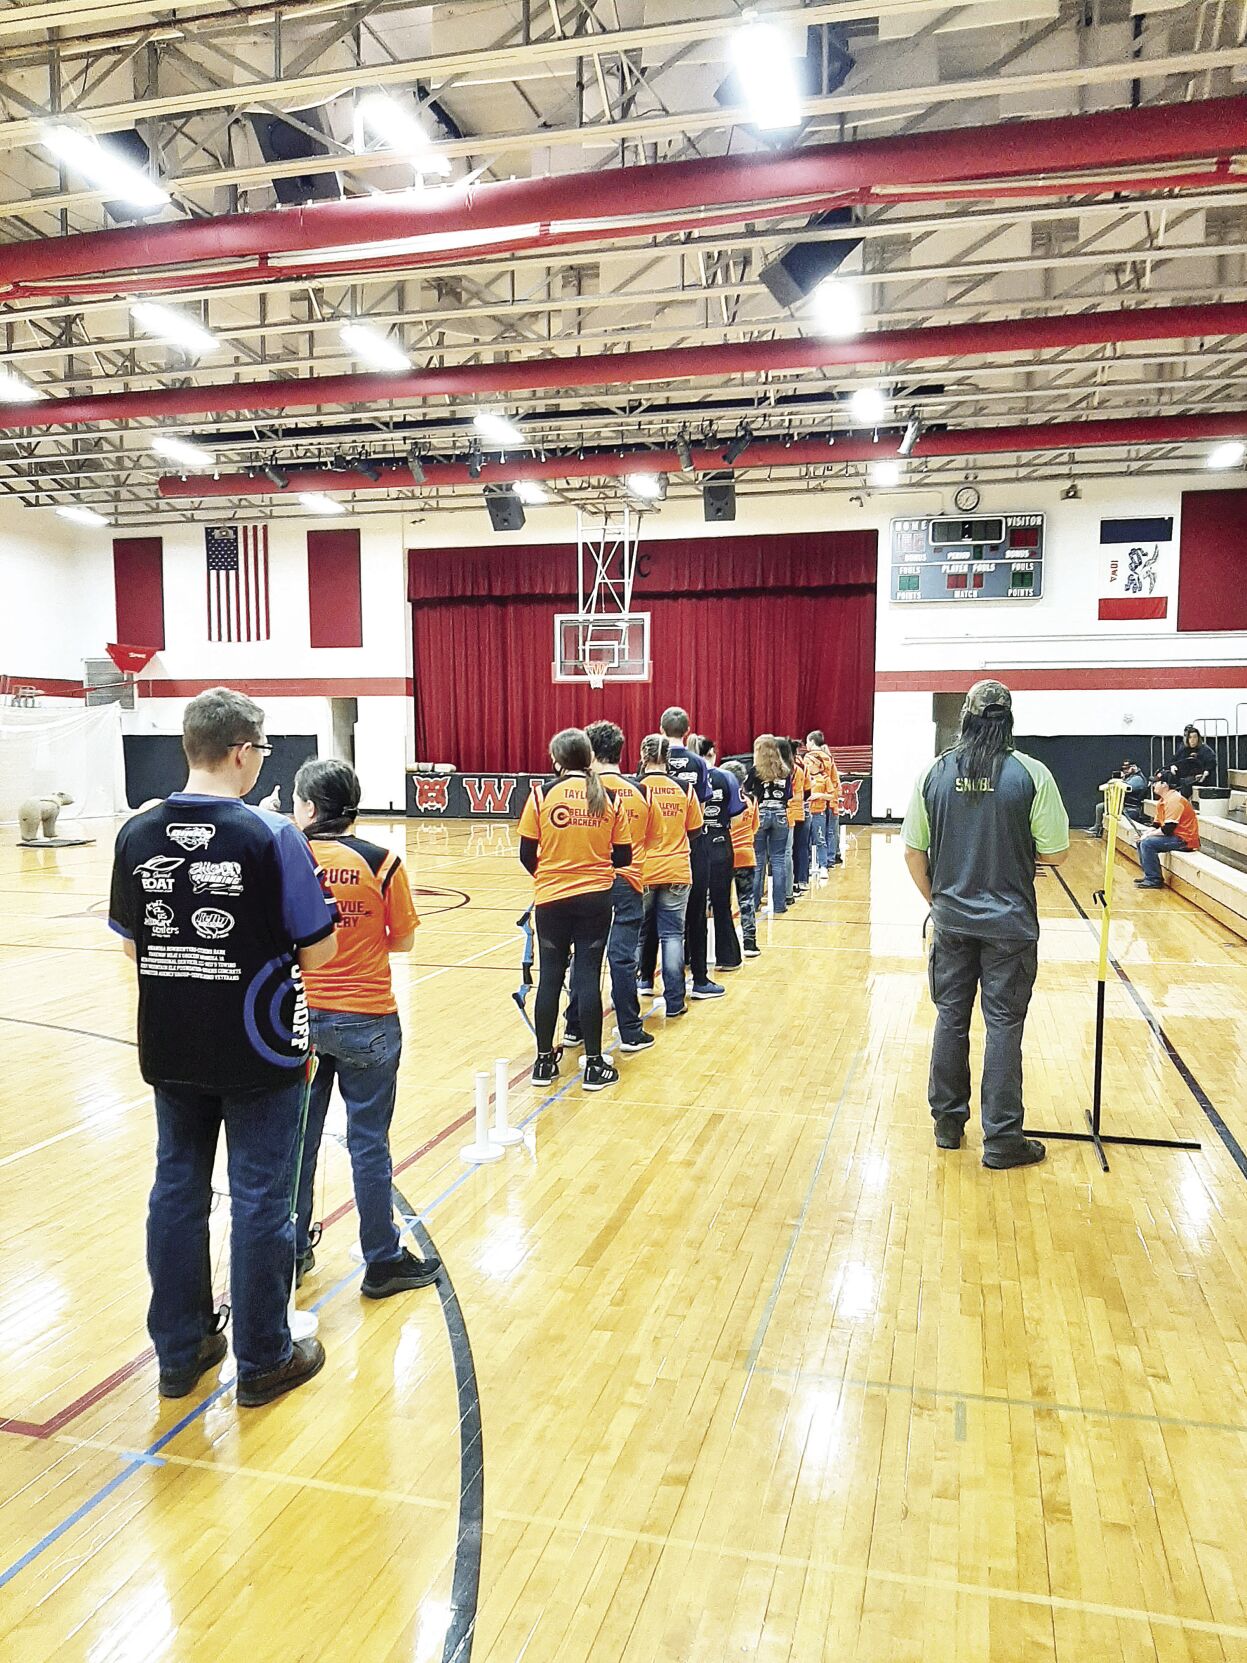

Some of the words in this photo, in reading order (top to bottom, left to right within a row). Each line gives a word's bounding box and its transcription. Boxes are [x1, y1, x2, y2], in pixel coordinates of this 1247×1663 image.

[895, 520, 927, 531] HOME
[1006, 516, 1042, 527] VISITOR
[941, 564, 969, 573] PLAYER
[1011, 562, 1034, 571] FOULS
[1109, 560, 1119, 583] IOWA
[896, 591, 922, 600] POINTS
[954, 590, 978, 598] MATCH
[1008, 588, 1034, 597] POINTS
[564, 788, 588, 799] TAYL
[614, 789, 633, 797] GER
[141, 878, 175, 890] BOAT
